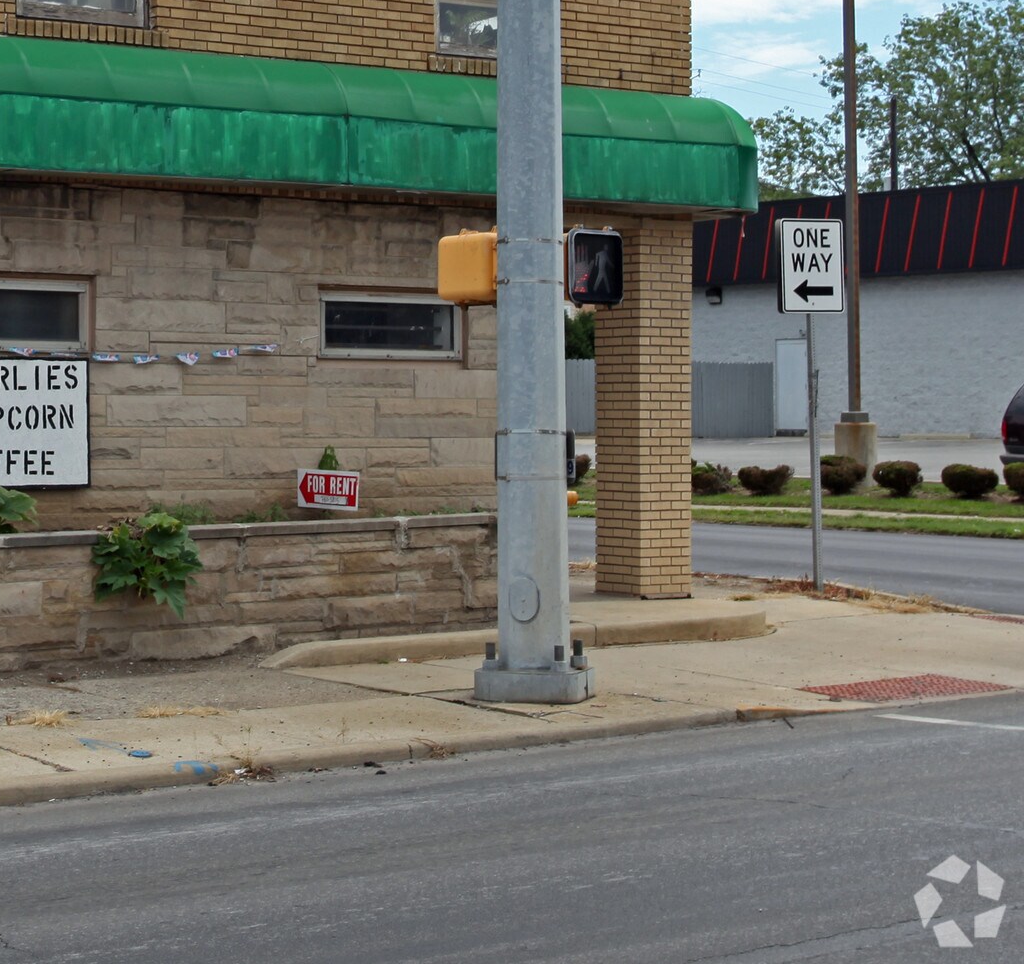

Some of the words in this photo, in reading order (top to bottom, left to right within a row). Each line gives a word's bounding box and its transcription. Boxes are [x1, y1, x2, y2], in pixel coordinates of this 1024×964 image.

[793, 228, 831, 248] ONE
[791, 253, 833, 273] WAY
[307, 475, 326, 494] FOR
[329, 477, 357, 496] RENT
